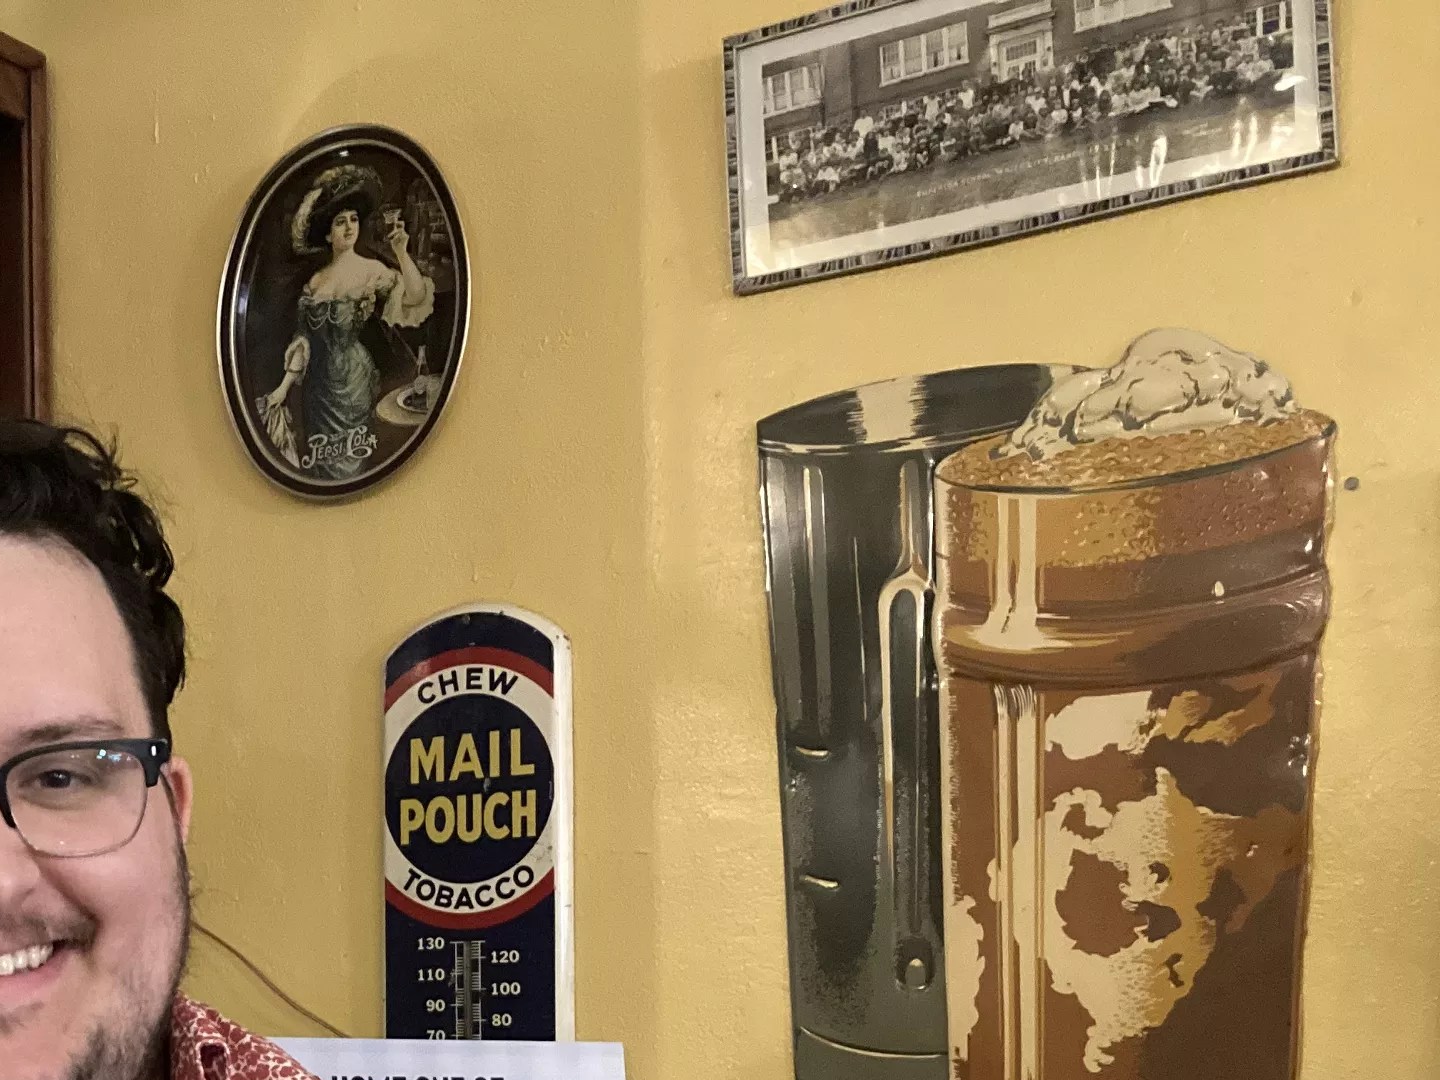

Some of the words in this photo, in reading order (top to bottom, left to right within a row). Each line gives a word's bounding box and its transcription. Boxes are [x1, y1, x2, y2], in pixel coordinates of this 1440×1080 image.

[417, 667, 519, 704] CHEW
[409, 727, 536, 786] MAIL
[399, 789, 537, 847] POUCH
[403, 864, 535, 911] TOBACCO
[417, 936, 445, 950] 130
[490, 950, 520, 963] 120
[417, 968, 446, 981] 110
[491, 982, 521, 995] 100
[426, 999, 446, 1012] 90
[491, 1013, 512, 1026] 80
[426, 1030, 446, 1040] 70
